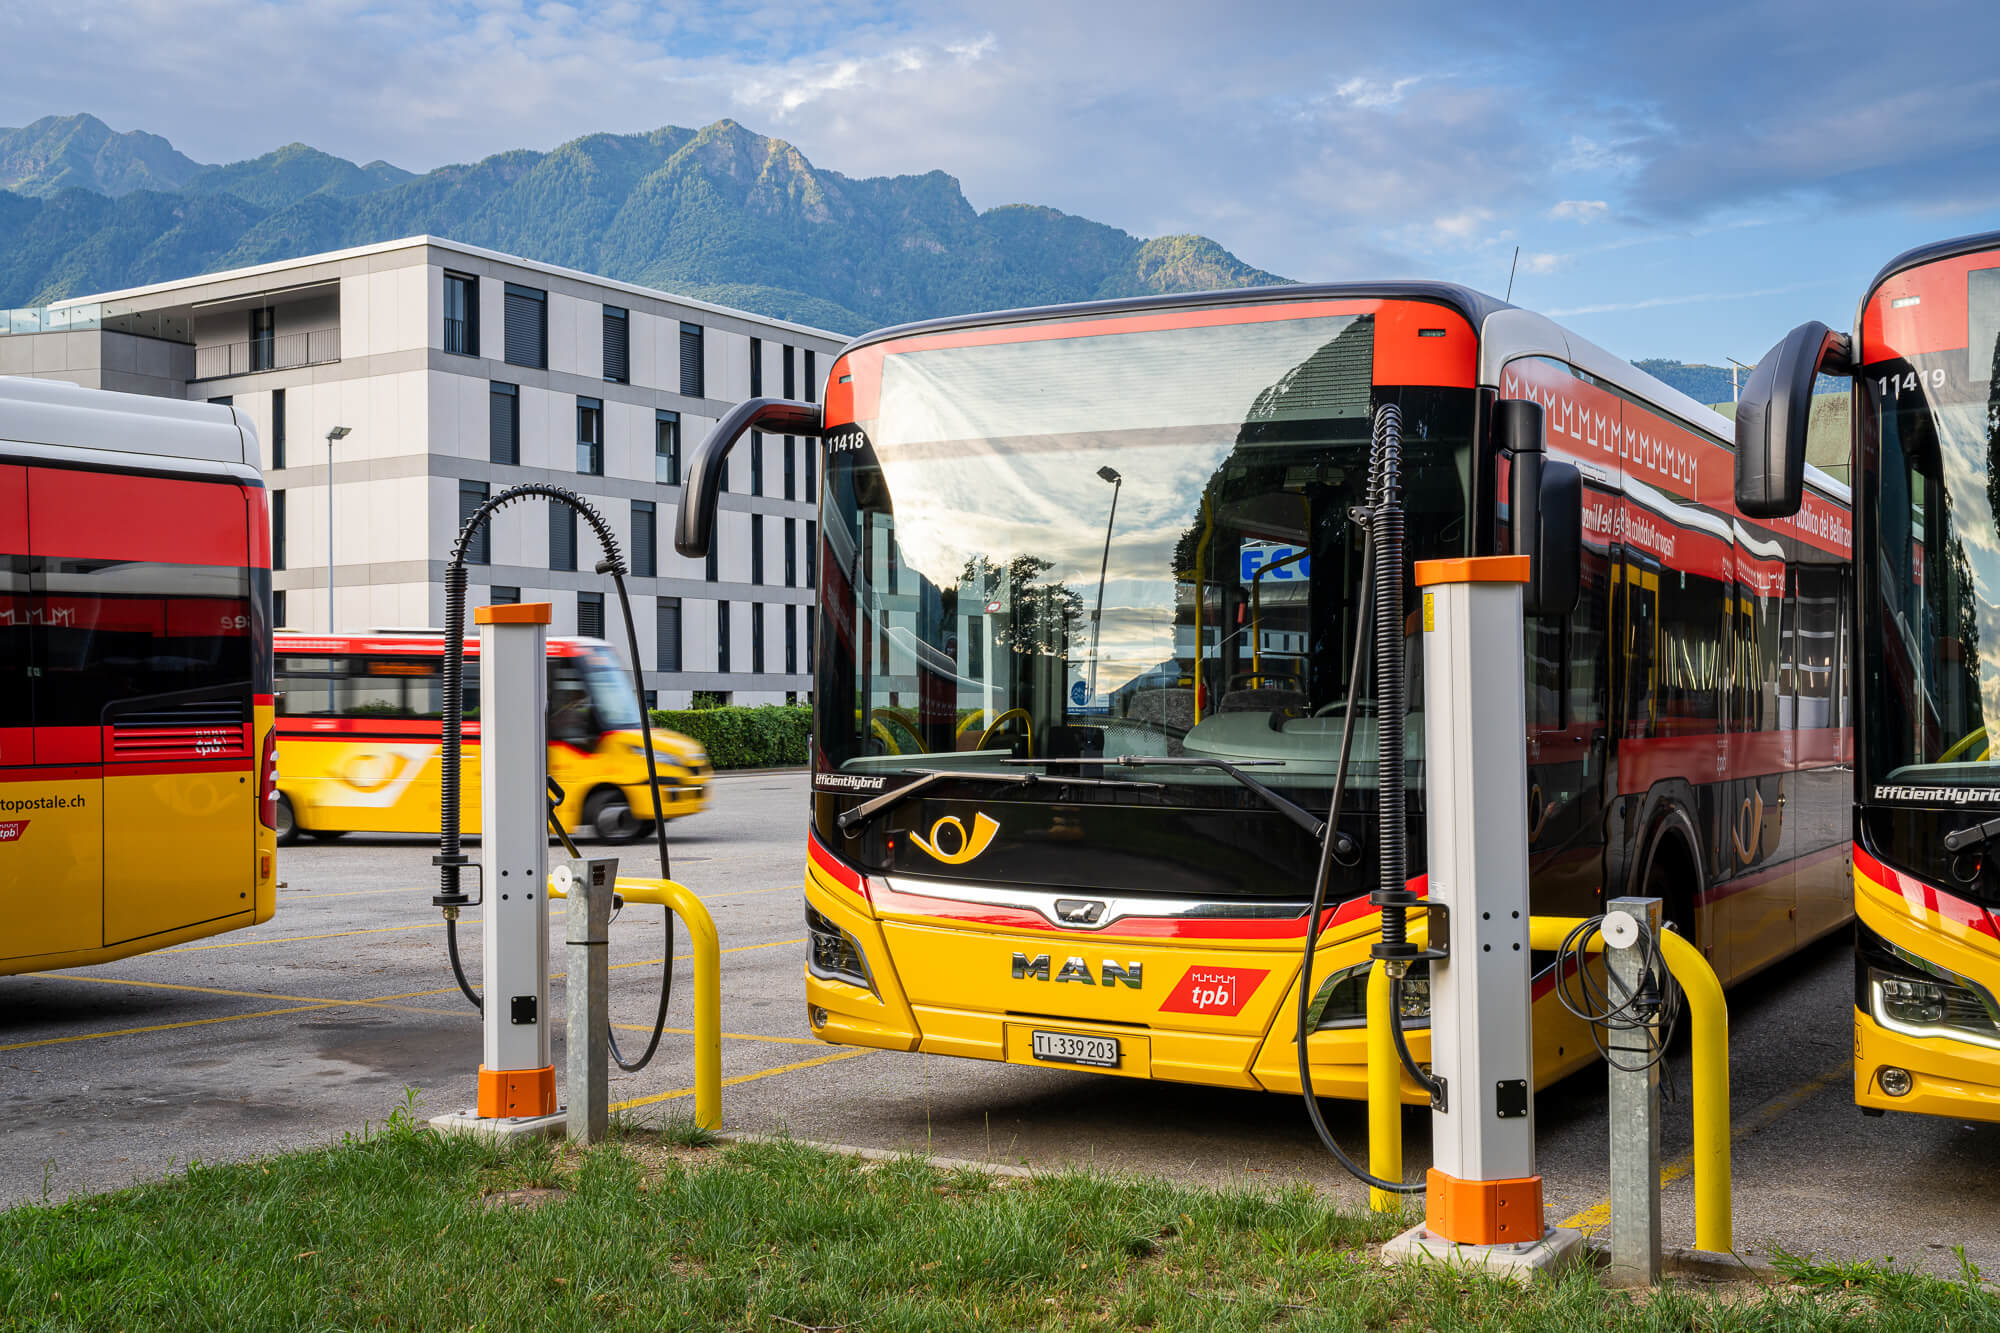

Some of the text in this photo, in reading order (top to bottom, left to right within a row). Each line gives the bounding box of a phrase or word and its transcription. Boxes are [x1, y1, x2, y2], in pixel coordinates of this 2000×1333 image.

[1878, 368, 1946, 396] 11419
[828, 431, 864, 454] 11418
[815, 774, 886, 790] EfficientHybrid
[0, 794, 85, 813] topostale.ch
[1011, 951, 1143, 990] MAN
[1191, 985, 1229, 1009] tpb
